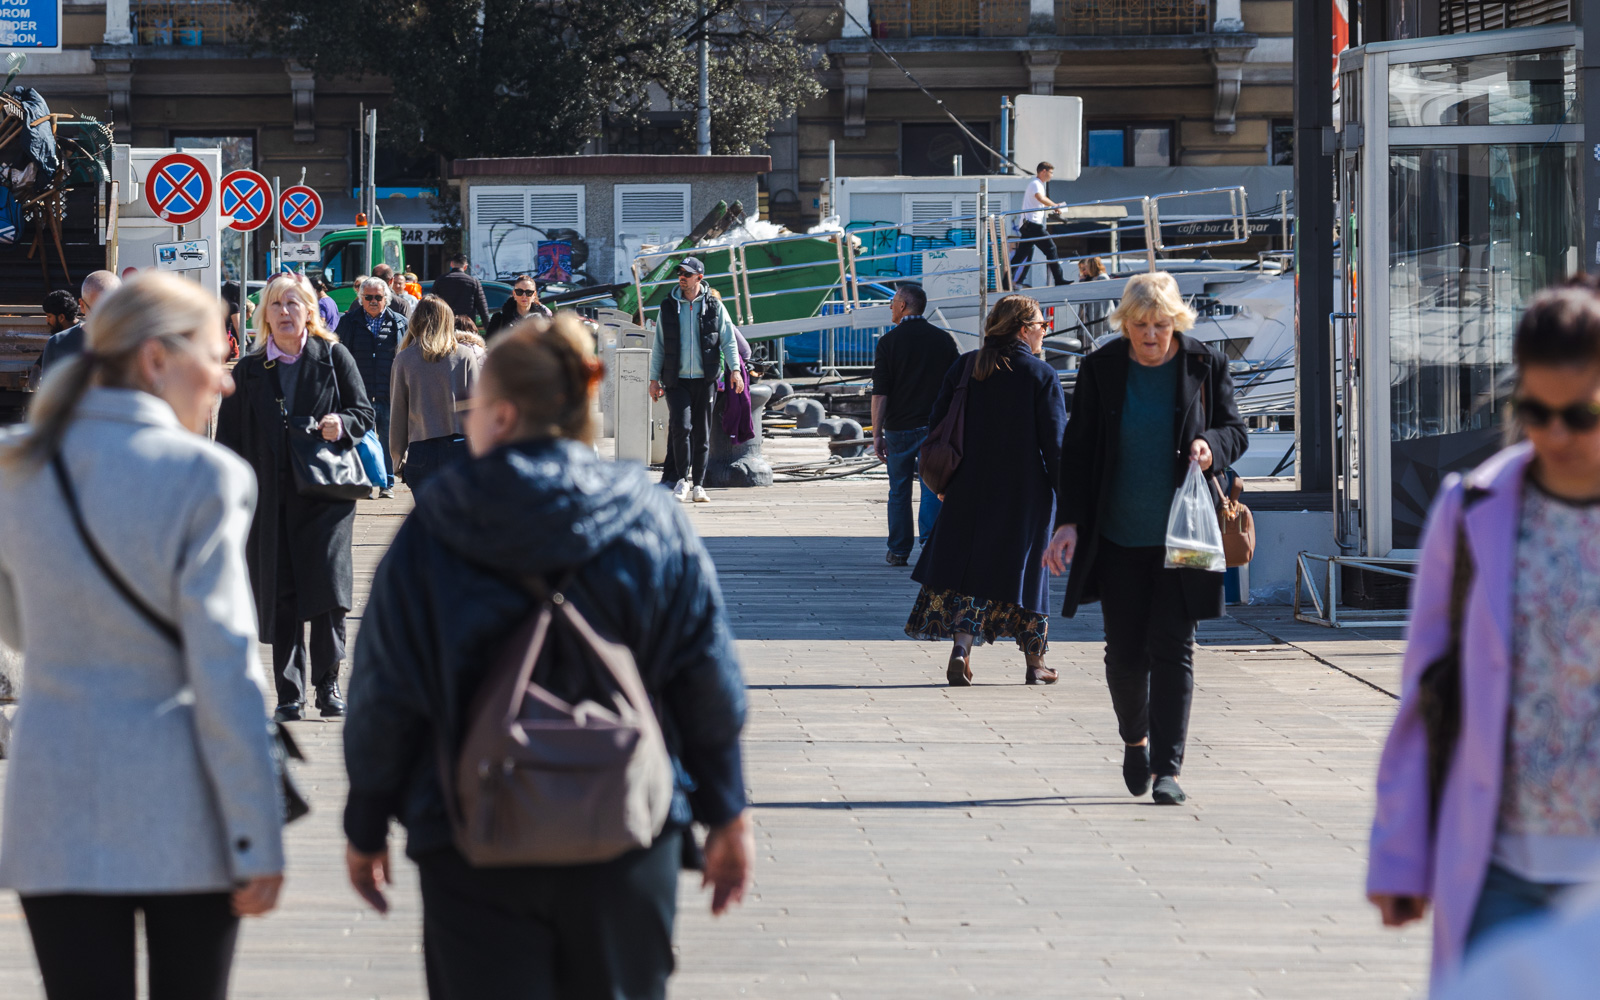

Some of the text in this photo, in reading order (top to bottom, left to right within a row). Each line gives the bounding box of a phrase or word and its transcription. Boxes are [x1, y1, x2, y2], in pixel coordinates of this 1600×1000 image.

[0, 8, 31, 18] ROM
[0, 20, 37, 31] NDER
[1177, 223, 1201, 235] caffe
[1203, 223, 1220, 233] bar
